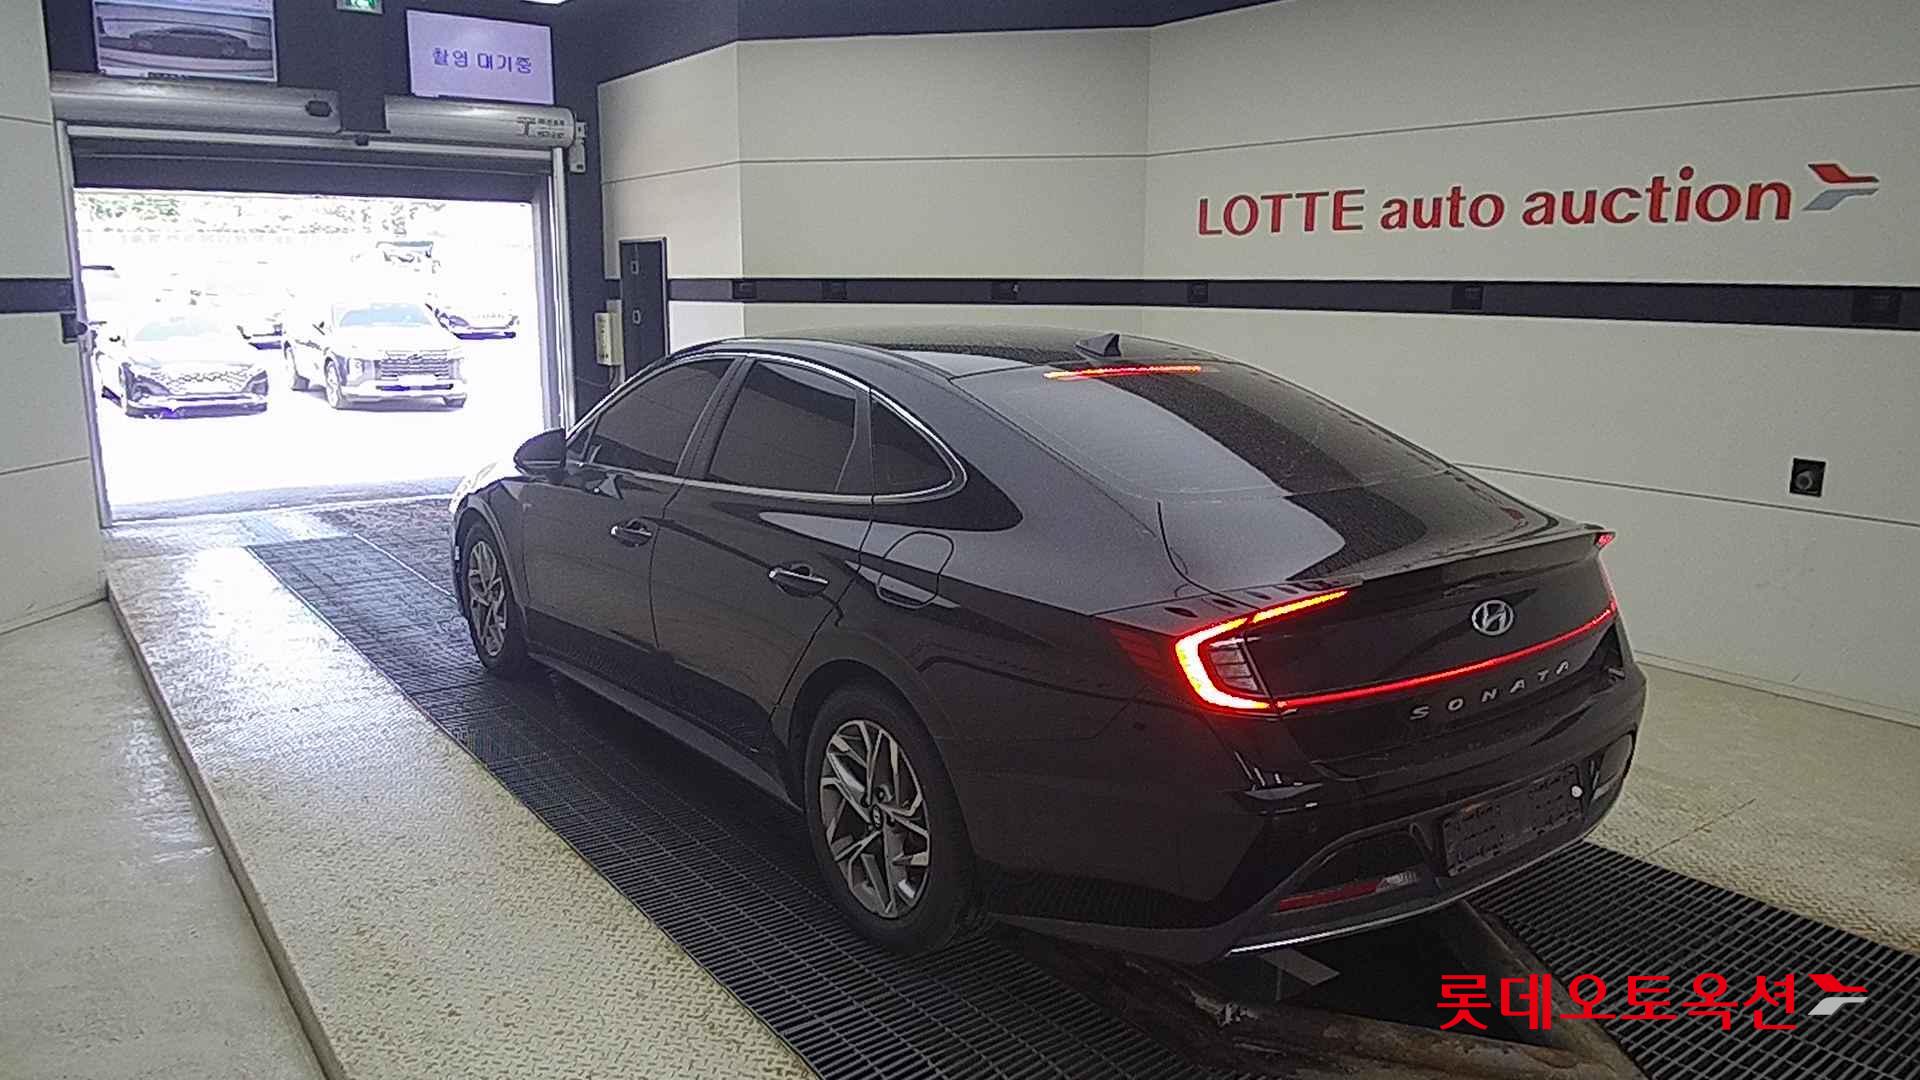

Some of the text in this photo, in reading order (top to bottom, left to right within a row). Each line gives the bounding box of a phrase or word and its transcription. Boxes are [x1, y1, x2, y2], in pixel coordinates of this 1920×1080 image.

[477, 53, 532, 74] 대기중
[1199, 165, 1792, 236] LOTTE auto auction
[1410, 660, 1569, 720] SONATA
